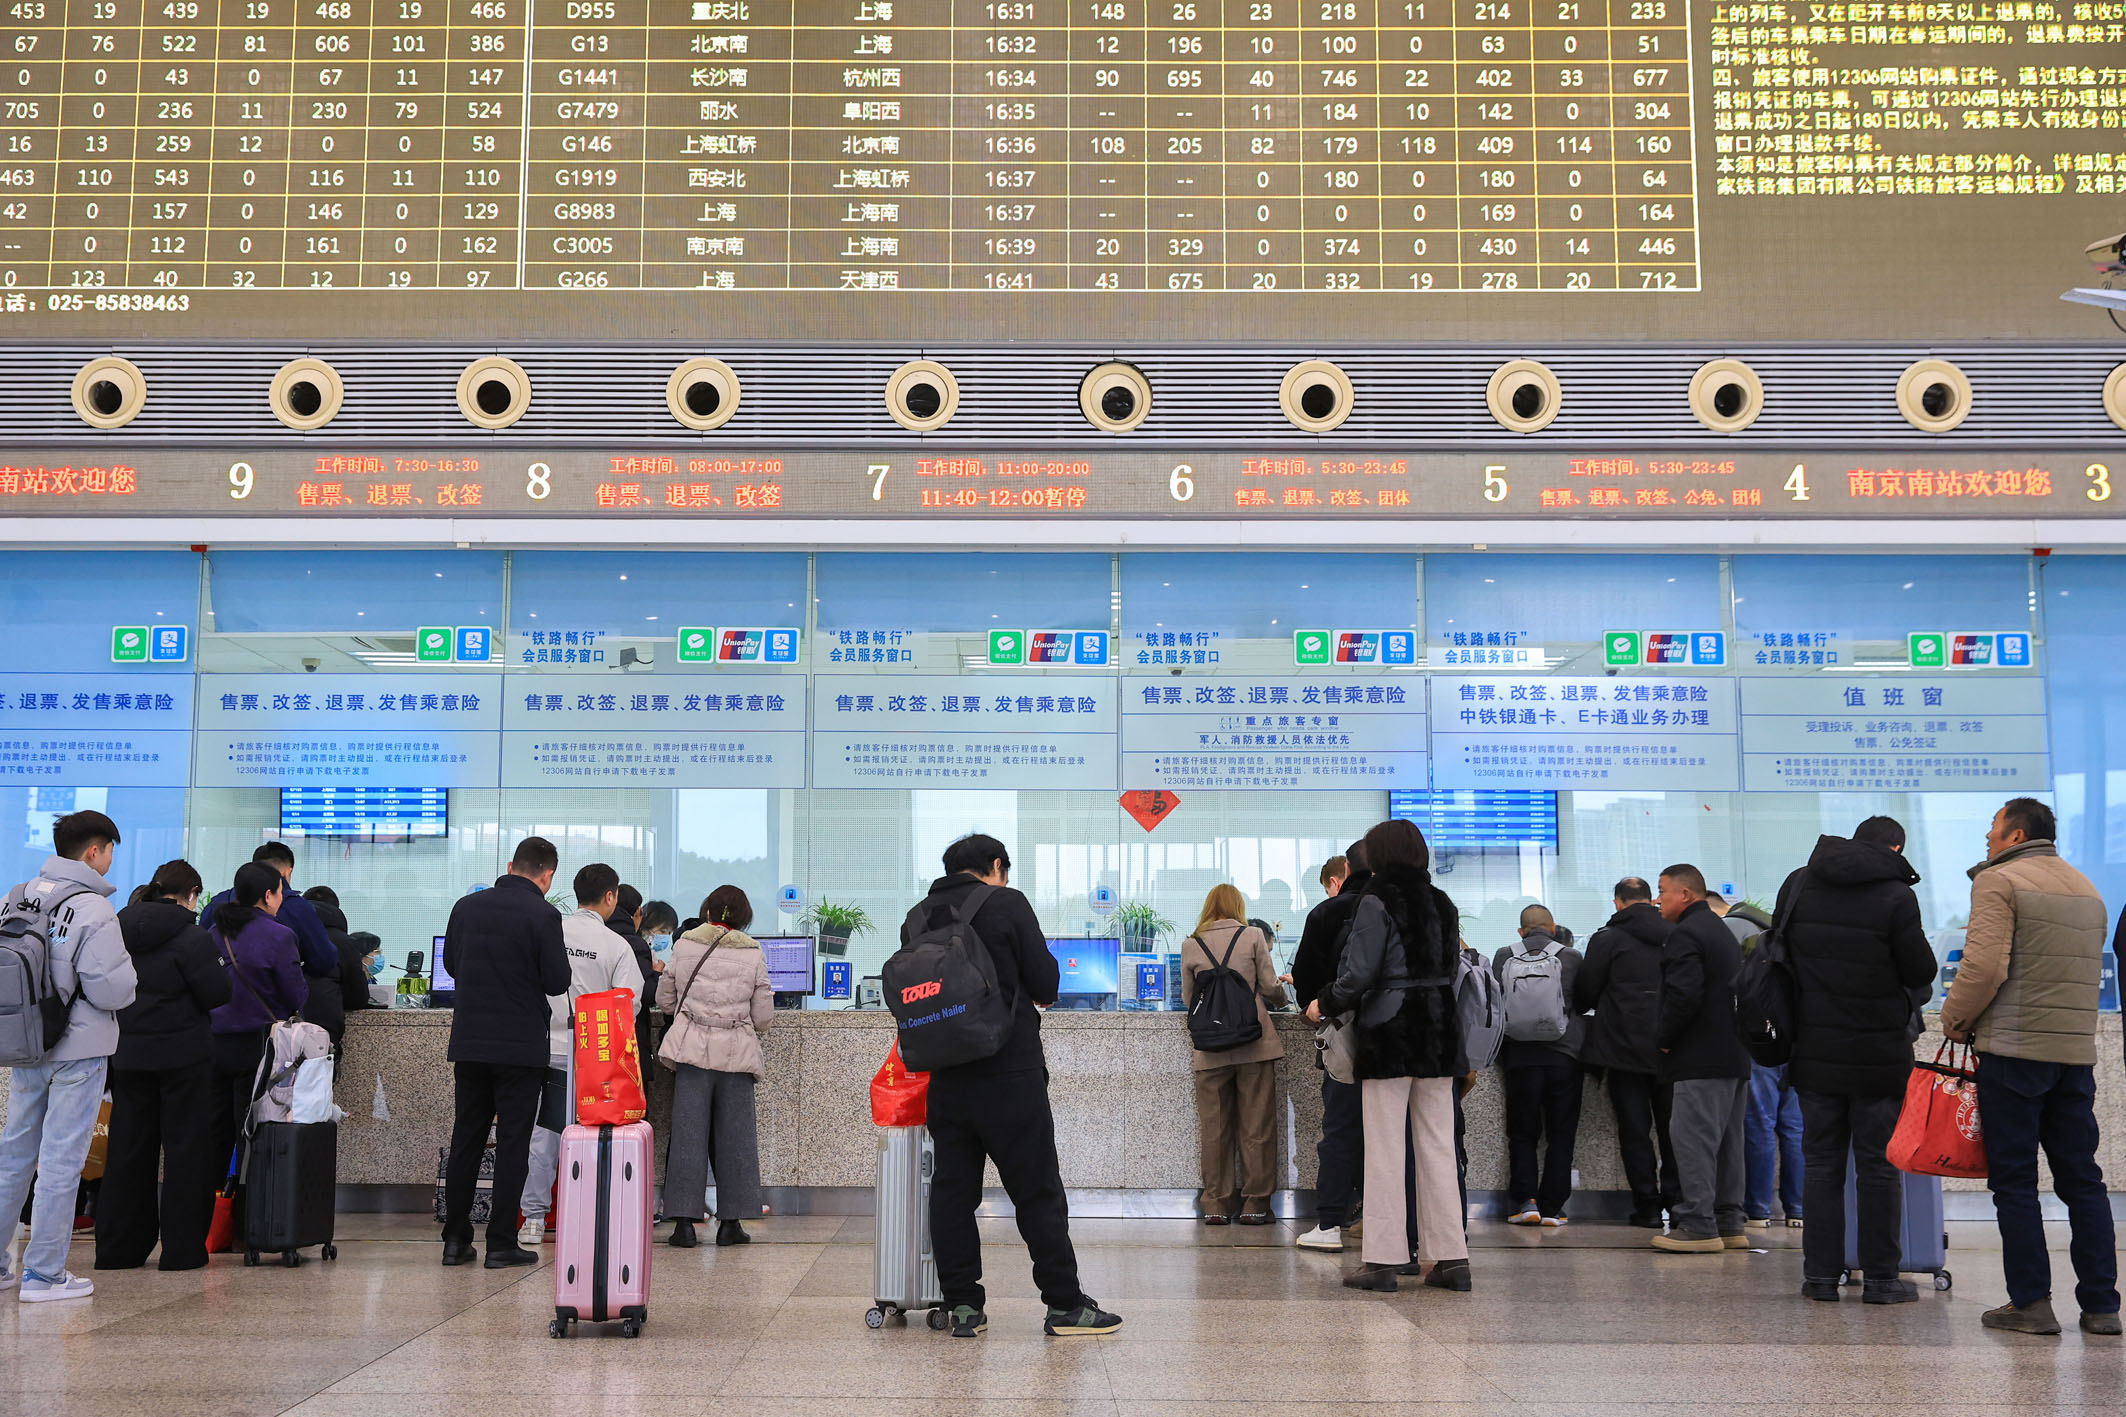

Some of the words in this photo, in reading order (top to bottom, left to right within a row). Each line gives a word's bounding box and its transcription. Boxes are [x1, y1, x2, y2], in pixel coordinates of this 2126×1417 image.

[567, 2, 615, 18] D955
[692, 1, 749, 20] 重庆北
[854, 2, 892, 20] 上海
[986, 3, 1033, 19] 16:31
[15, 36, 38, 52] 67
[92, 36, 114, 51] 76
[163, 36, 196, 51] 522
[245, 36, 266, 52] 81
[316, 36, 350, 52] 606
[392, 36, 425, 51] 101
[471, 36, 504, 51] 386
[572, 36, 608, 52] G13
[691, 35, 748, 53] 北京南
[854, 35, 892, 53] 上海
[986, 37, 1036, 53] 16:32
[559, 69, 616, 85] G1441
[691, 68, 747, 86] 长沙南
[843, 68, 901, 87] 杭州西
[986, 70, 1036, 86] 16:34
[1096, 70, 1119, 86] 90
[1168, 70, 1201, 87] 695
[1250, 71, 1274, 87] 40
[1321, 70, 1357, 87] 746
[1406, 70, 1429, 86] 22
[1476, 70, 1512, 86] 402
[1561, 70, 1583, 86] 33
[1634, 69, 1668, 86] 677
[558, 102, 618, 118] G7479
[700, 101, 738, 120] 丽水
[843, 102, 900, 120] 阜阳西
[986, 104, 1035, 120] 16:35
[562, 136, 612, 152] G146
[680, 135, 756, 153] 上海虹桥
[842, 136, 900, 154] 北京南
[986, 137, 1036, 153] 16:36
[1091, 137, 1125, 153] 108
[1168, 138, 1202, 154] 205
[1251, 137, 1274, 154] 82
[1324, 137, 1357, 154] 179
[1401, 137, 1436, 154] 118
[1478, 137, 1513, 153] 409
[1557, 137, 1592, 153] 114
[1636, 136, 1671, 153] 160
[555, 170, 617, 185] G1919
[688, 169, 746, 187] 西安北
[833, 169, 910, 188] 上海虹桥
[985, 171, 1036, 187] 16:37
[554, 204, 615, 219] G8983
[697, 203, 736, 221] 上海
[841, 203, 899, 222] 上海南
[985, 205, 1035, 221] 16:37
[553, 237, 612, 253] C3005
[687, 236, 744, 255] 南京南
[841, 237, 899, 256] 上海南
[985, 239, 1035, 255] 16:39
[558, 273, 608, 288] G266
[696, 272, 735, 289] 上海
[840, 272, 898, 289] 天津西
[985, 273, 1035, 288] 16:41
[0, 294, 189, 312] 话：025-85838463
[0, 465, 137, 496] 南站欢迎您
[229, 463, 253, 498] 9
[526, 464, 550, 499] 8
[867, 466, 890, 499] 7
[1170, 466, 1193, 500] 6
[1484, 466, 1507, 500] 5
[1783, 466, 1809, 500] 4
[1846, 467, 2053, 498] 南京南站欢迎您
[2086, 466, 2110, 500] 3
[295, 481, 483, 509] 售票、退票、改签
[594, 481, 782, 510] 售票、退票、改签
[921, 485, 1088, 510] 11:40-12:00暂停
[1232, 486, 1411, 508] 售票、退票、改签、团体
[1034, 640, 1070, 648] UnionPay
[1340, 640, 1376, 648] UnionPay
[1650, 641, 1686, 650] UnionPay
[522, 649, 604, 663] 会员服务窗口
[830, 649, 912, 662] 会员服务窗口
[1137, 650, 1219, 663] 会员服务窗口
[1445, 650, 1528, 663] 会员服务窗口
[1755, 651, 1837, 664] 会员服务窗口
[220, 693, 480, 711] 售票、改签、退票、发售乘意险
[524, 694, 785, 711] 售票、改签、退票、发售乘意险
[1141, 686, 1406, 704] 售票、改签、退票、发售乘意险
[1459, 685, 1708, 701] 售票、改签、退票、发售乘意险
[1843, 687, 1943, 707] 值班窗
[835, 694, 1096, 713] 售票、改签、退票、发售乘意险
[1245, 716, 1338, 726] 重点旅客专窗
[1460, 708, 1711, 727] 中铁银通卡、E卡通业务办理
[0, 753, 159, 762] 购票时主动提出，或在行程结束后登录
[908, 1012, 941, 1028] Concrete
[941, 1004, 966, 1018] Nailer
[596, 1009, 611, 1062] 喝加多宝
